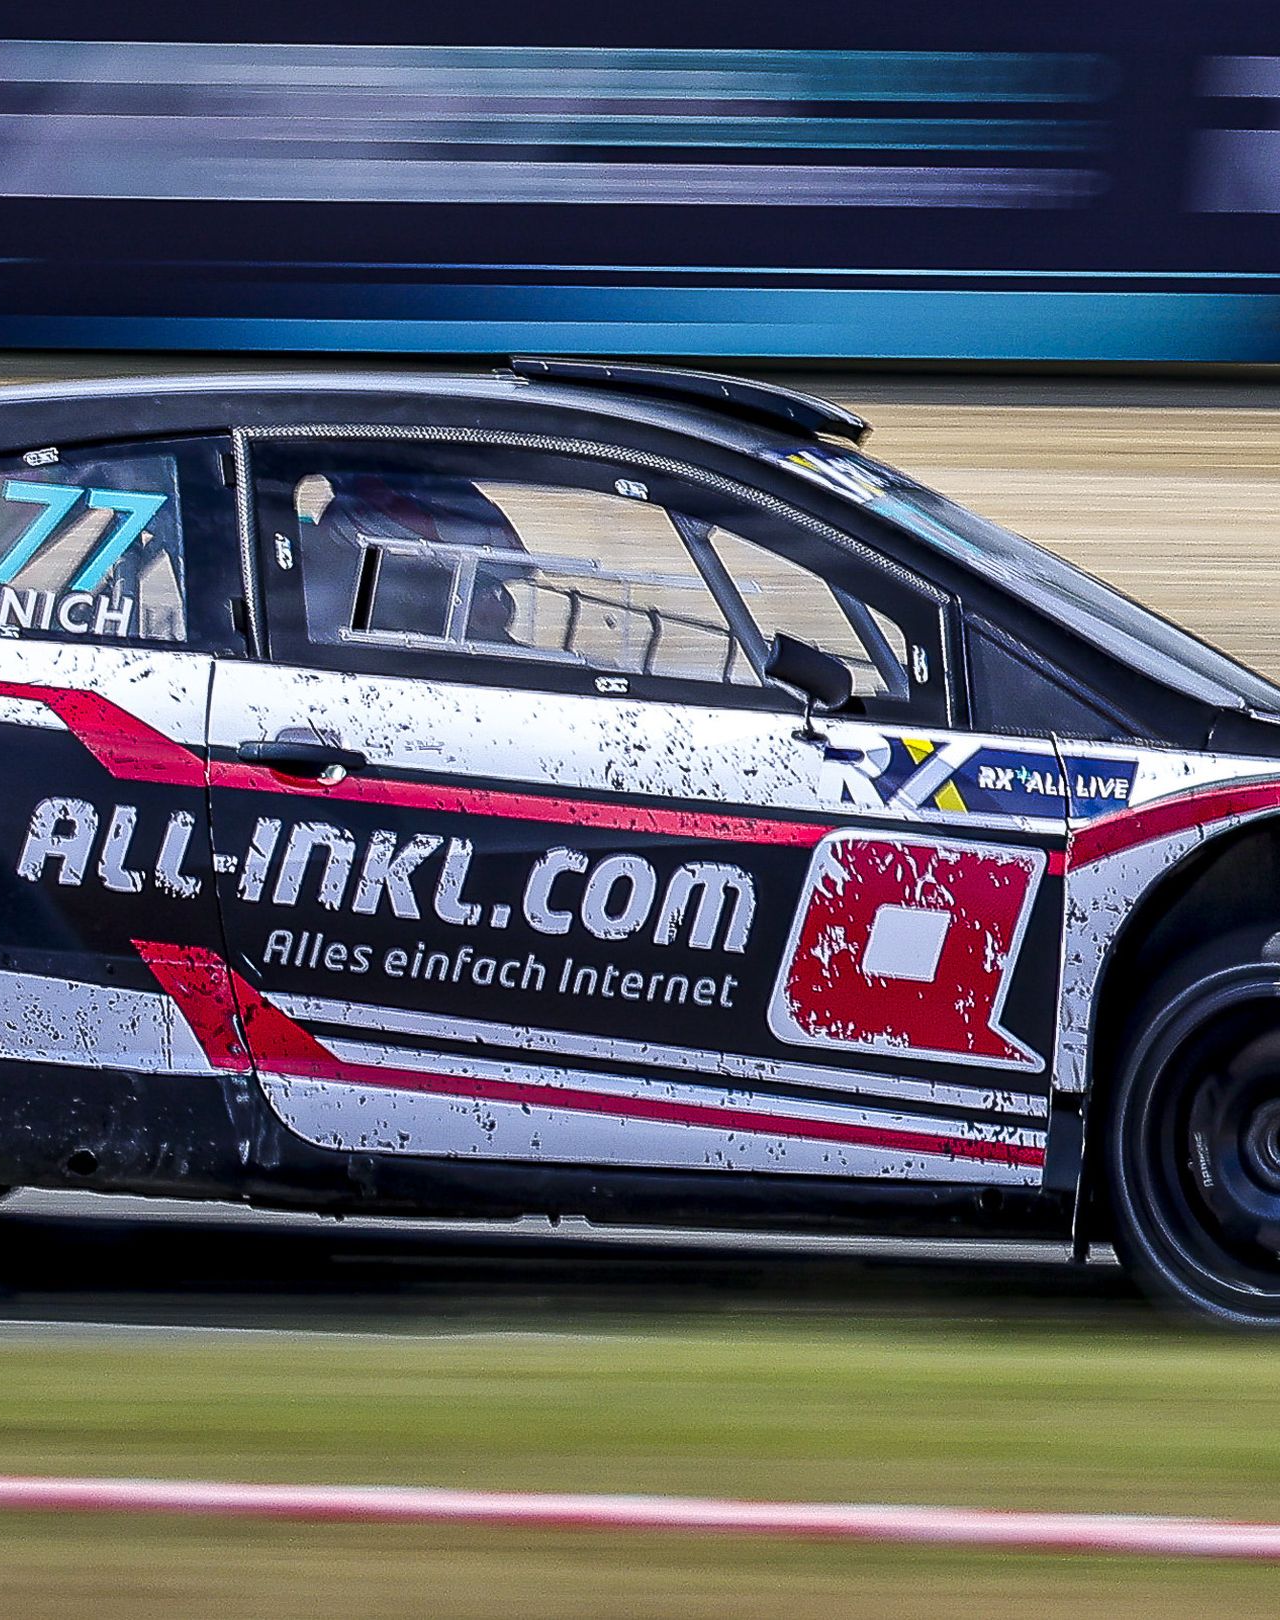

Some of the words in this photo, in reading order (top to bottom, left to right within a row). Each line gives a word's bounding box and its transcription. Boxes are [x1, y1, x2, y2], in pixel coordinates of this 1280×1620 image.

[1076, 773, 1130, 799] LIVE
[263, 928, 370, 976] Alles
[384, 937, 543, 993] einfach
[557, 953, 739, 1009] Internet
